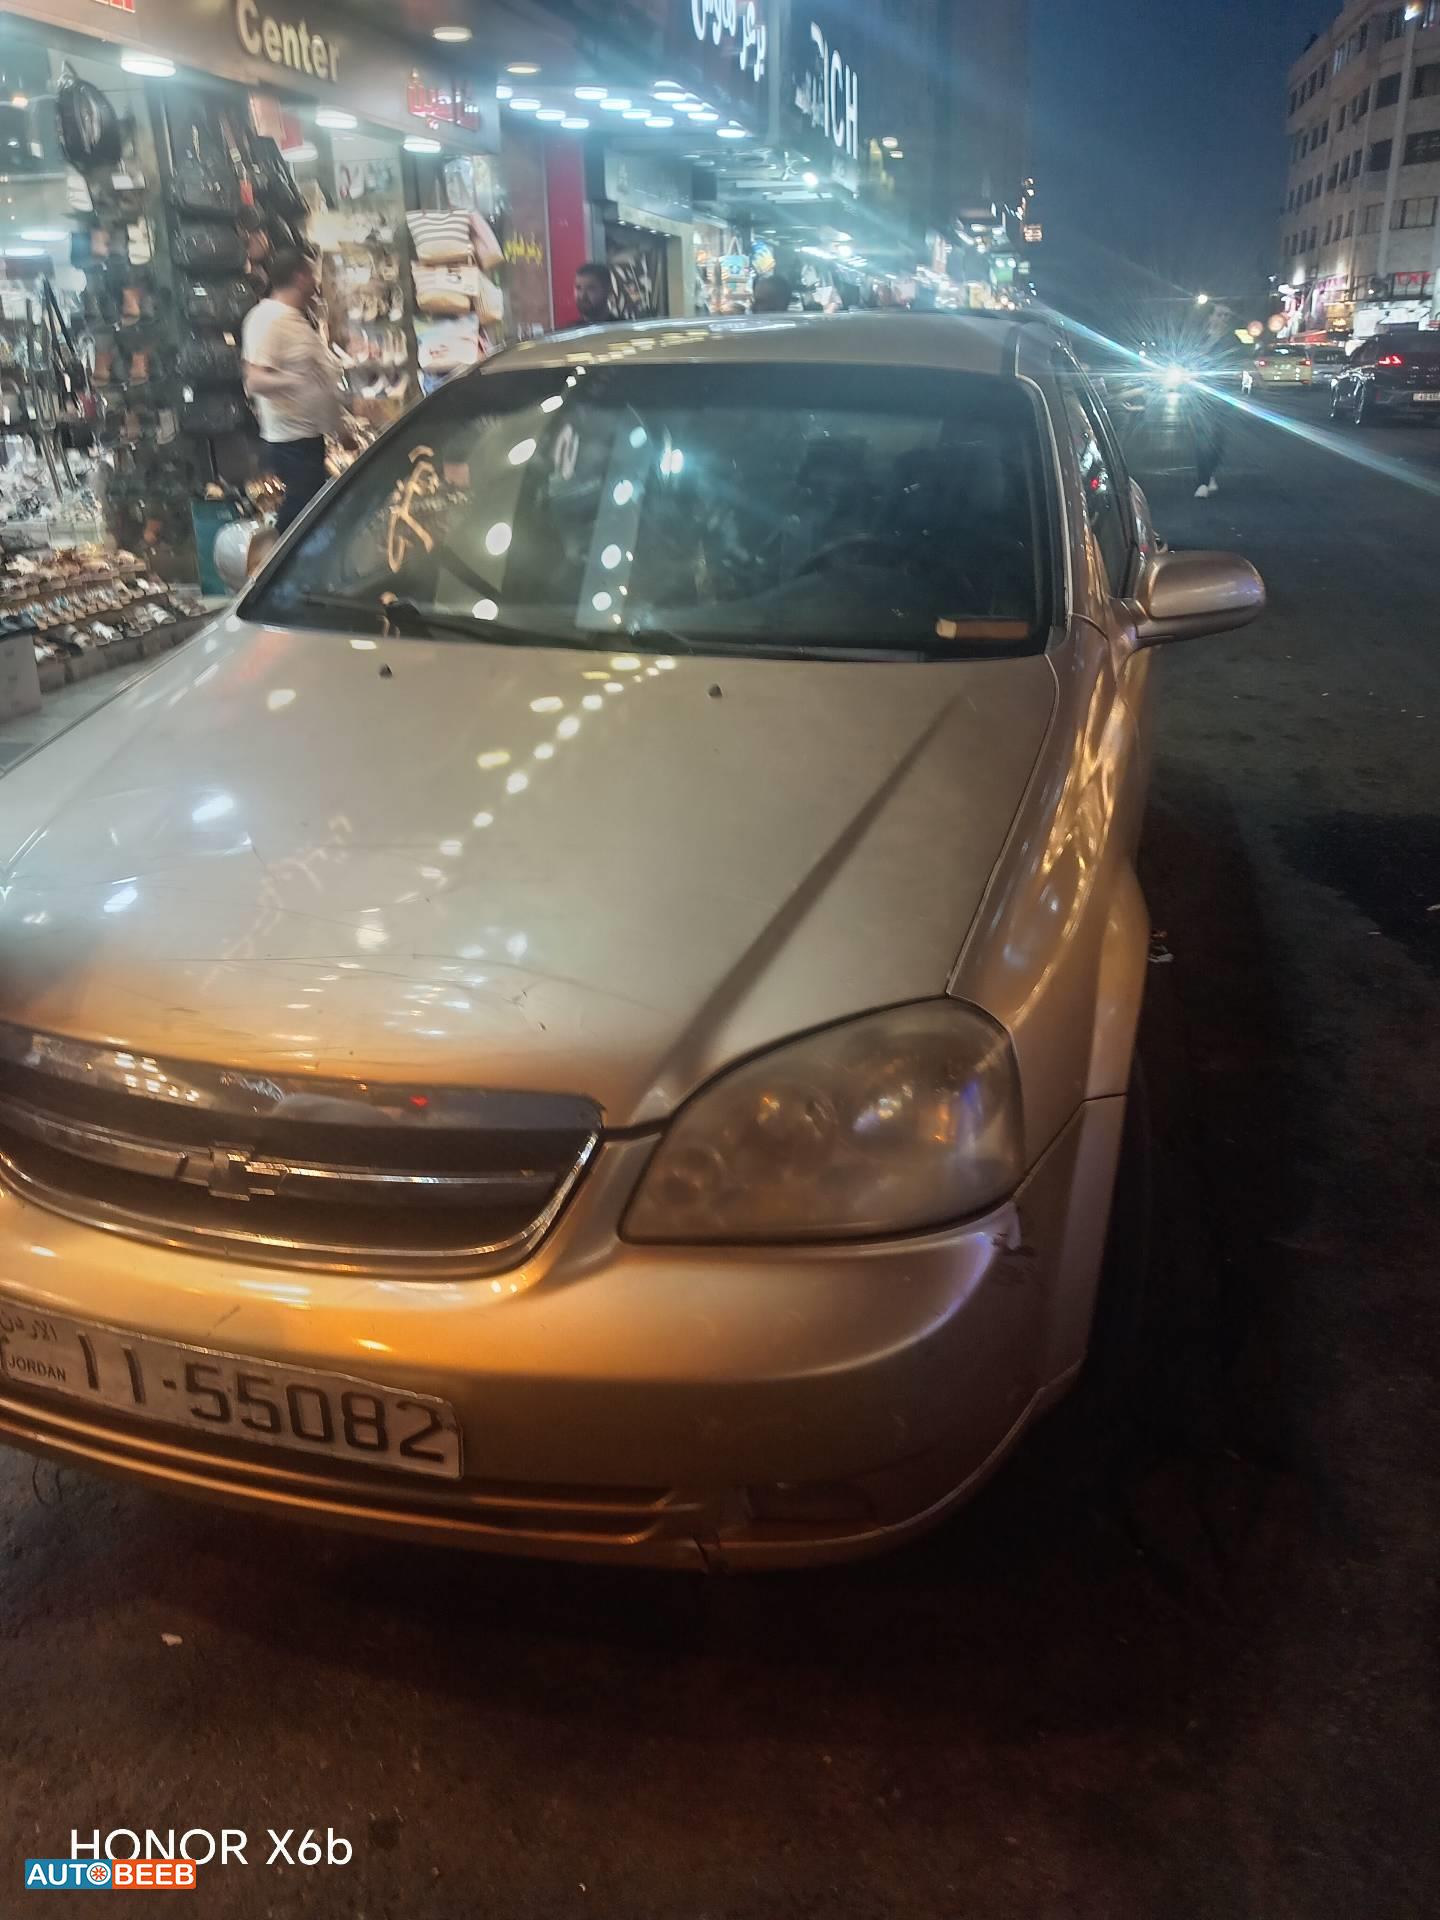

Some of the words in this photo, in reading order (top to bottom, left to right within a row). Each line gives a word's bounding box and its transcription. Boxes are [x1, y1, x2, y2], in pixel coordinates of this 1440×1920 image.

[234, 0, 342, 83] Center
[7, 1354, 66, 1382] JORDAN
[77, 1330, 445, 1463] 11-55082
